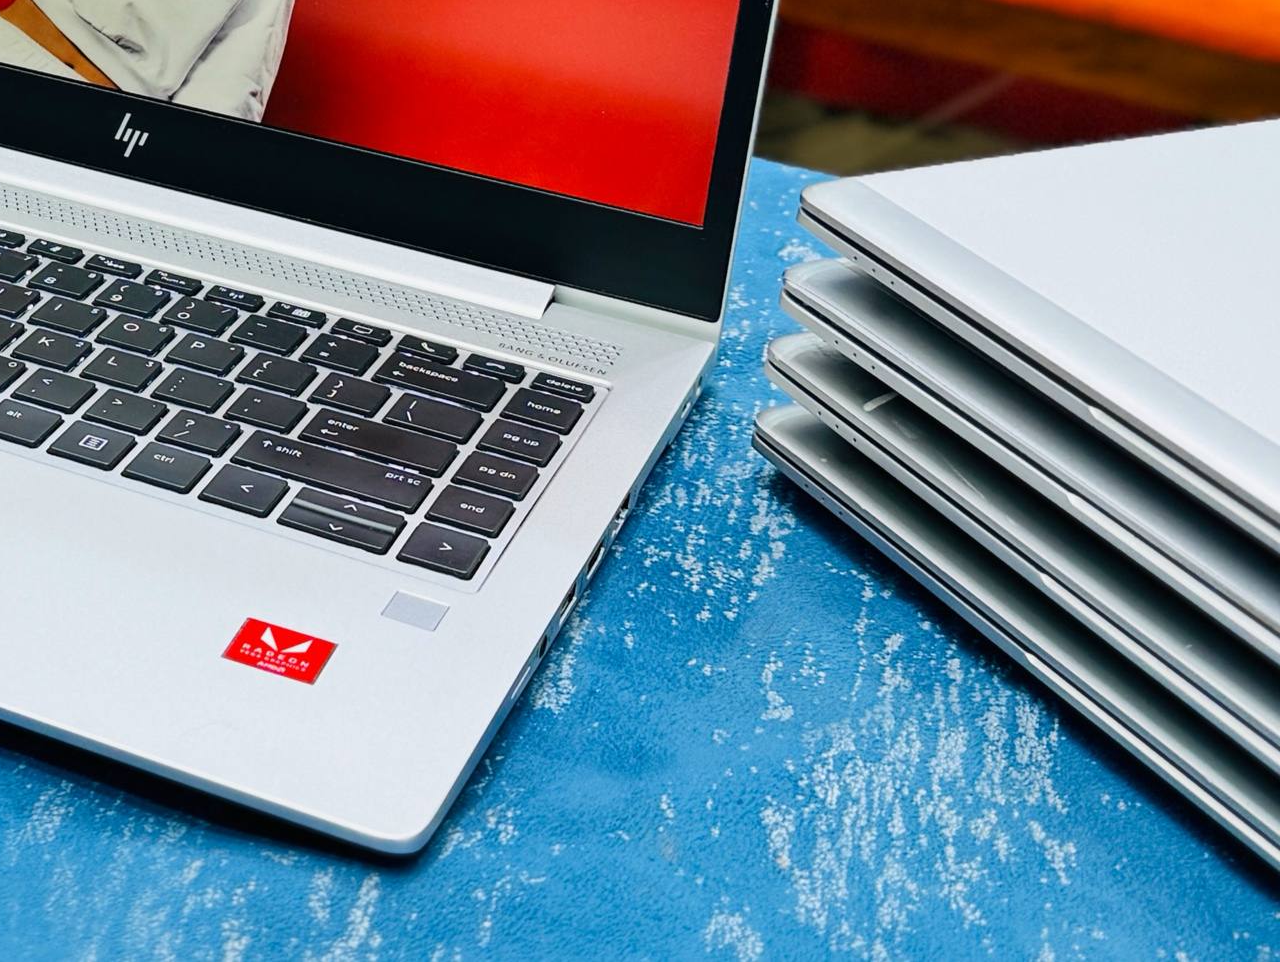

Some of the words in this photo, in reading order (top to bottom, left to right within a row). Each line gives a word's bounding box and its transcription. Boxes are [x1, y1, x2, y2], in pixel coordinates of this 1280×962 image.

[114, 112, 149, 158] hp
[123, 322, 140, 332] O
[37, 336, 55, 347] K
[190, 340, 206, 349] P
[107, 356, 118, 366] L
[398, 360, 459, 383] backspace
[545, 378, 583, 393] delete
[6, 410, 22, 418] alt
[527, 401, 561, 415] home
[327, 418, 360, 432] enter
[503, 433, 521, 442] pg
[523, 438, 539, 447] up
[153, 454, 175, 464] ctrl
[275, 446, 302, 458] shift
[384, 470, 405, 483] prt
[407, 478, 421, 486] sc
[478, 466, 497, 475] pg
[499, 471, 516, 480] dn
[460, 503, 486, 514] end
[242, 642, 310, 668] RADEON
